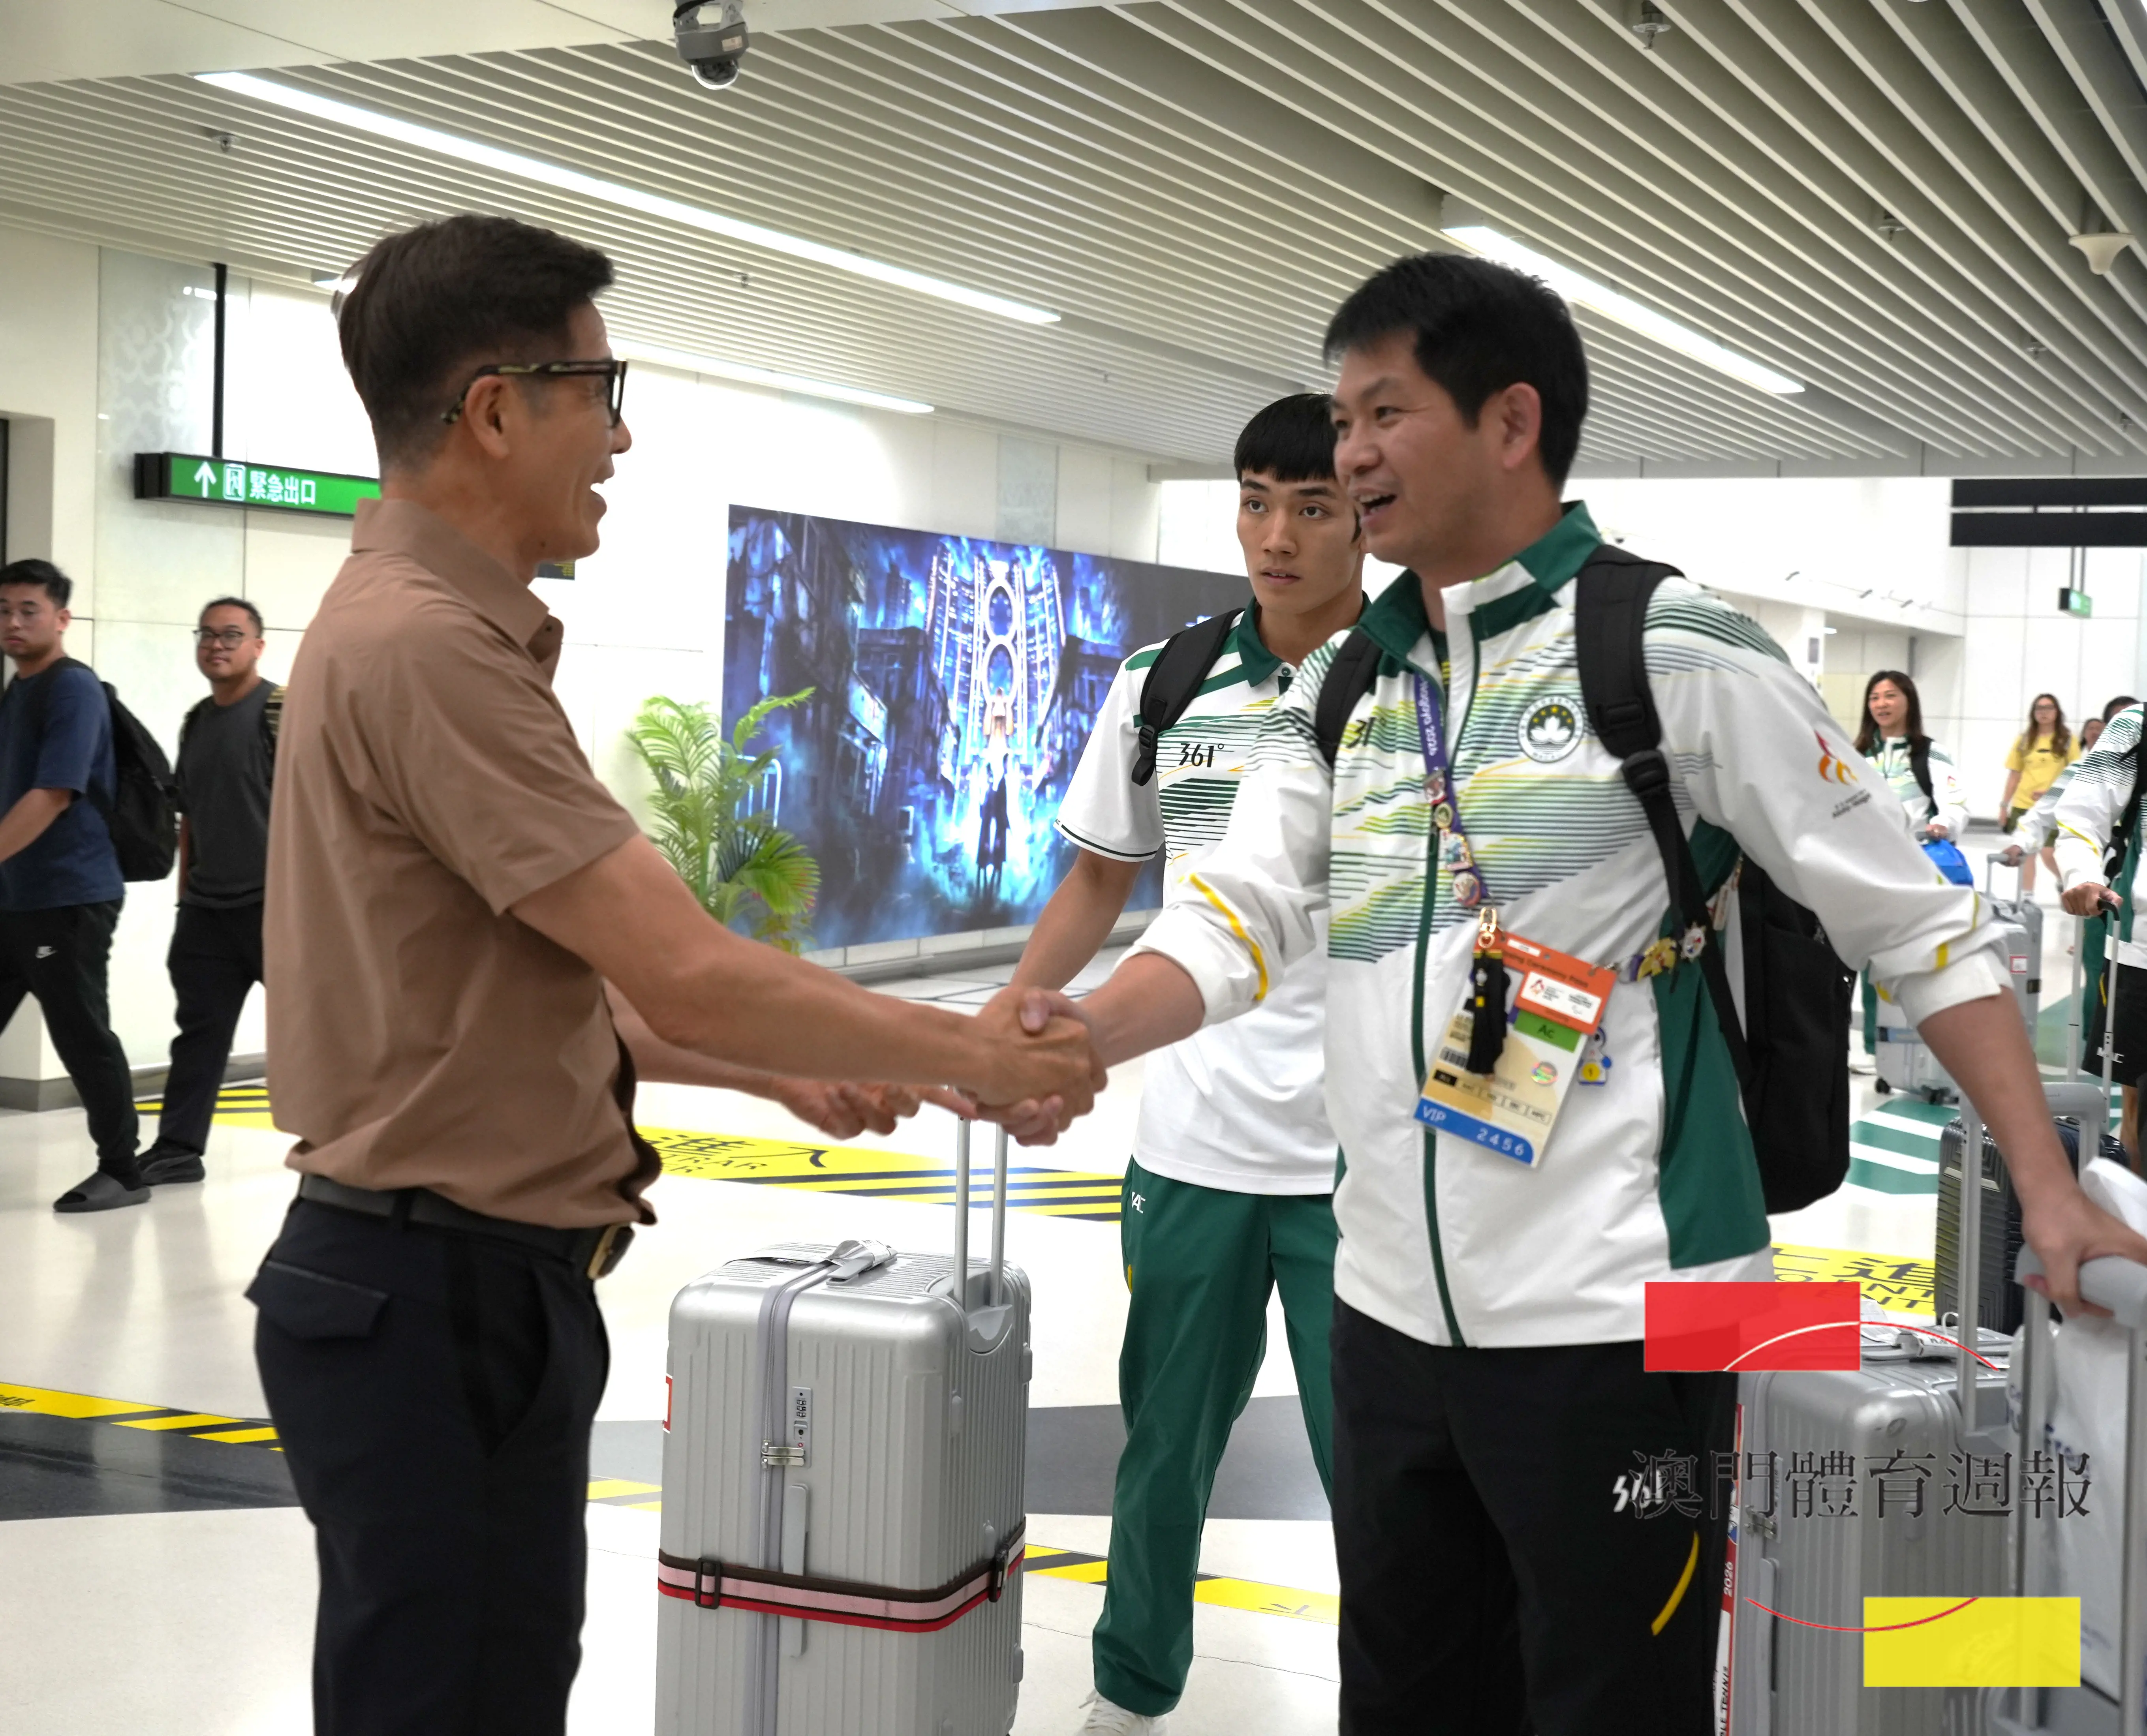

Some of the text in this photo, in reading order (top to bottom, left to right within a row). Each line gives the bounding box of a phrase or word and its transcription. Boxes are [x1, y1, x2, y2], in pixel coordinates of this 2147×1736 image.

[250, 470, 316, 505] 緊急出口
[1423, 1105, 1446, 1122] VIP
[1723, 1561, 1734, 1597] 2026
